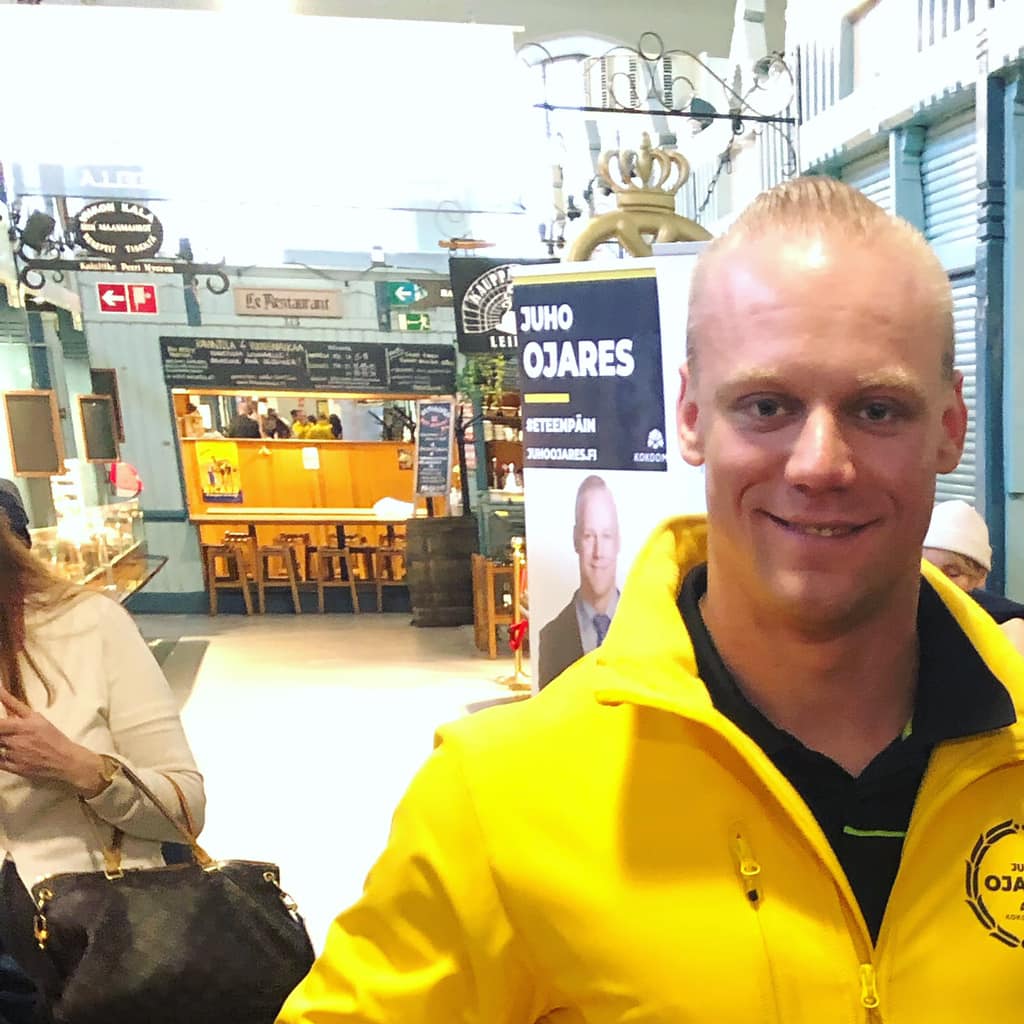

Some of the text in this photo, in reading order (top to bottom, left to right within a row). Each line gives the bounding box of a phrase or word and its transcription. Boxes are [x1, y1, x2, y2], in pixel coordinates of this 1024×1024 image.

[469, 267, 511, 304] KAUPP
[519, 304, 573, 331] JUHO
[522, 339, 635, 379] OJARES
[526, 413, 596, 434] #ETEENPÄIN
[526, 447, 597, 463] JUHOOJARES.FI
